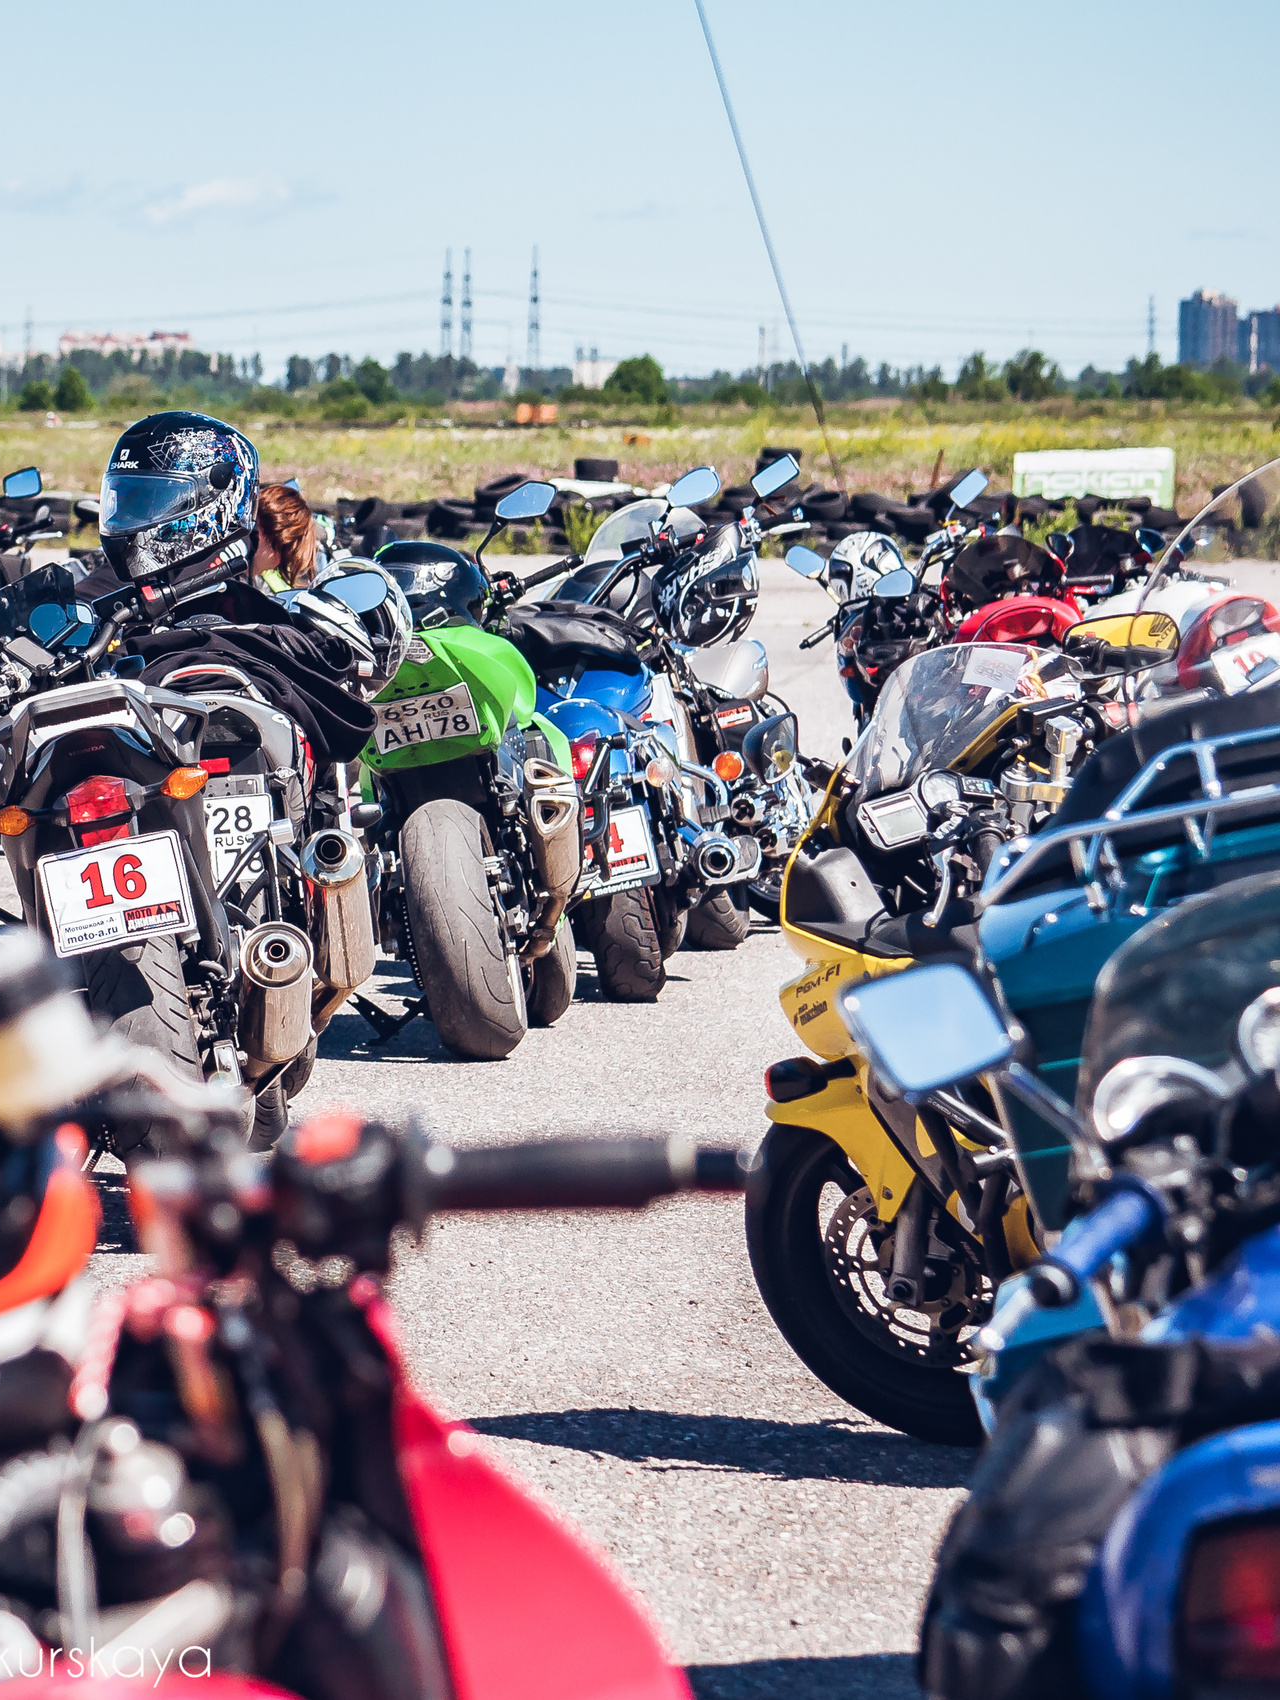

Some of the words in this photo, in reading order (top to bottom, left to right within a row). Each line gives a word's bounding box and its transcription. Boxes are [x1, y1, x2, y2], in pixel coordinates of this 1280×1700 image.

[110, 461, 139, 470] SHARK
[1025, 468, 1162, 489] nokian
[384, 696, 454, 721] 6540
[423, 709, 450, 720] RUS
[432, 714, 470, 736] 78
[212, 805, 252, 835] 28
[215, 836, 246, 848] RUS
[81, 854, 147, 909] 16
[594, 879, 643, 897] motovid.ru
[64, 920, 105, 933] Мотошкола
[67, 926, 119, 945] moto-a.ru
